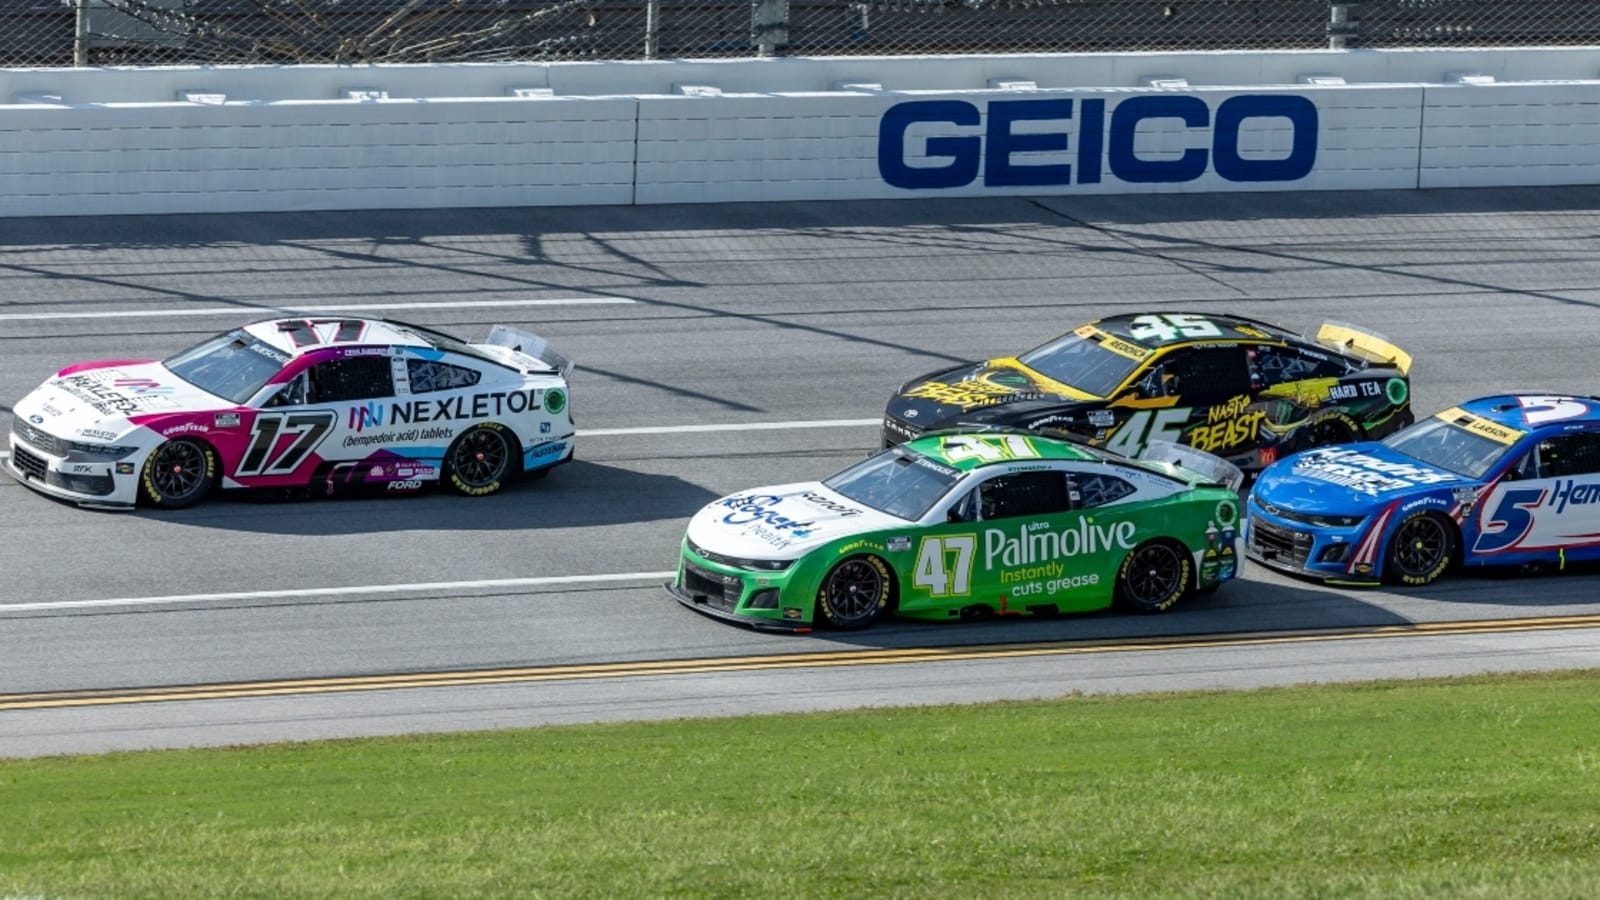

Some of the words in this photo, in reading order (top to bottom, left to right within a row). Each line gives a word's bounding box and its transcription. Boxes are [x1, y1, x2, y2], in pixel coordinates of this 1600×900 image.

[878, 95, 1318, 190] GEICO
[1130, 314, 1223, 341] 45
[1329, 385, 1359, 399] HARD
[1359, 381, 1382, 396] TEA
[390, 390, 540, 425] NEXLETOL
[1208, 394, 1251, 424] NASTY
[163, 422, 209, 436] GOODYEAR
[396, 428, 419, 442] acid)
[420, 427, 453, 441] tablets
[1028, 414, 1075, 430] GOODYEAR
[1190, 411, 1267, 452] BEAST
[1473, 421, 1510, 439] LARSON
[233, 411, 338, 478] 17
[387, 480, 422, 490] FORD
[1548, 479, 1600, 514] Hen
[1402, 497, 1448, 511] GOODYEAR
[1028, 521, 1050, 531] ultra
[1472, 488, 1549, 555] 5
[839, 540, 884, 554] GOODYEAR
[985, 514, 1138, 571] Palmolive
[912, 533, 978, 598] 47
[1001, 561, 1065, 583] Instantly
[867, 555, 891, 608] GOODYEAR
[1012, 584, 1043, 597] cuts
[1046, 573, 1099, 595] grease
